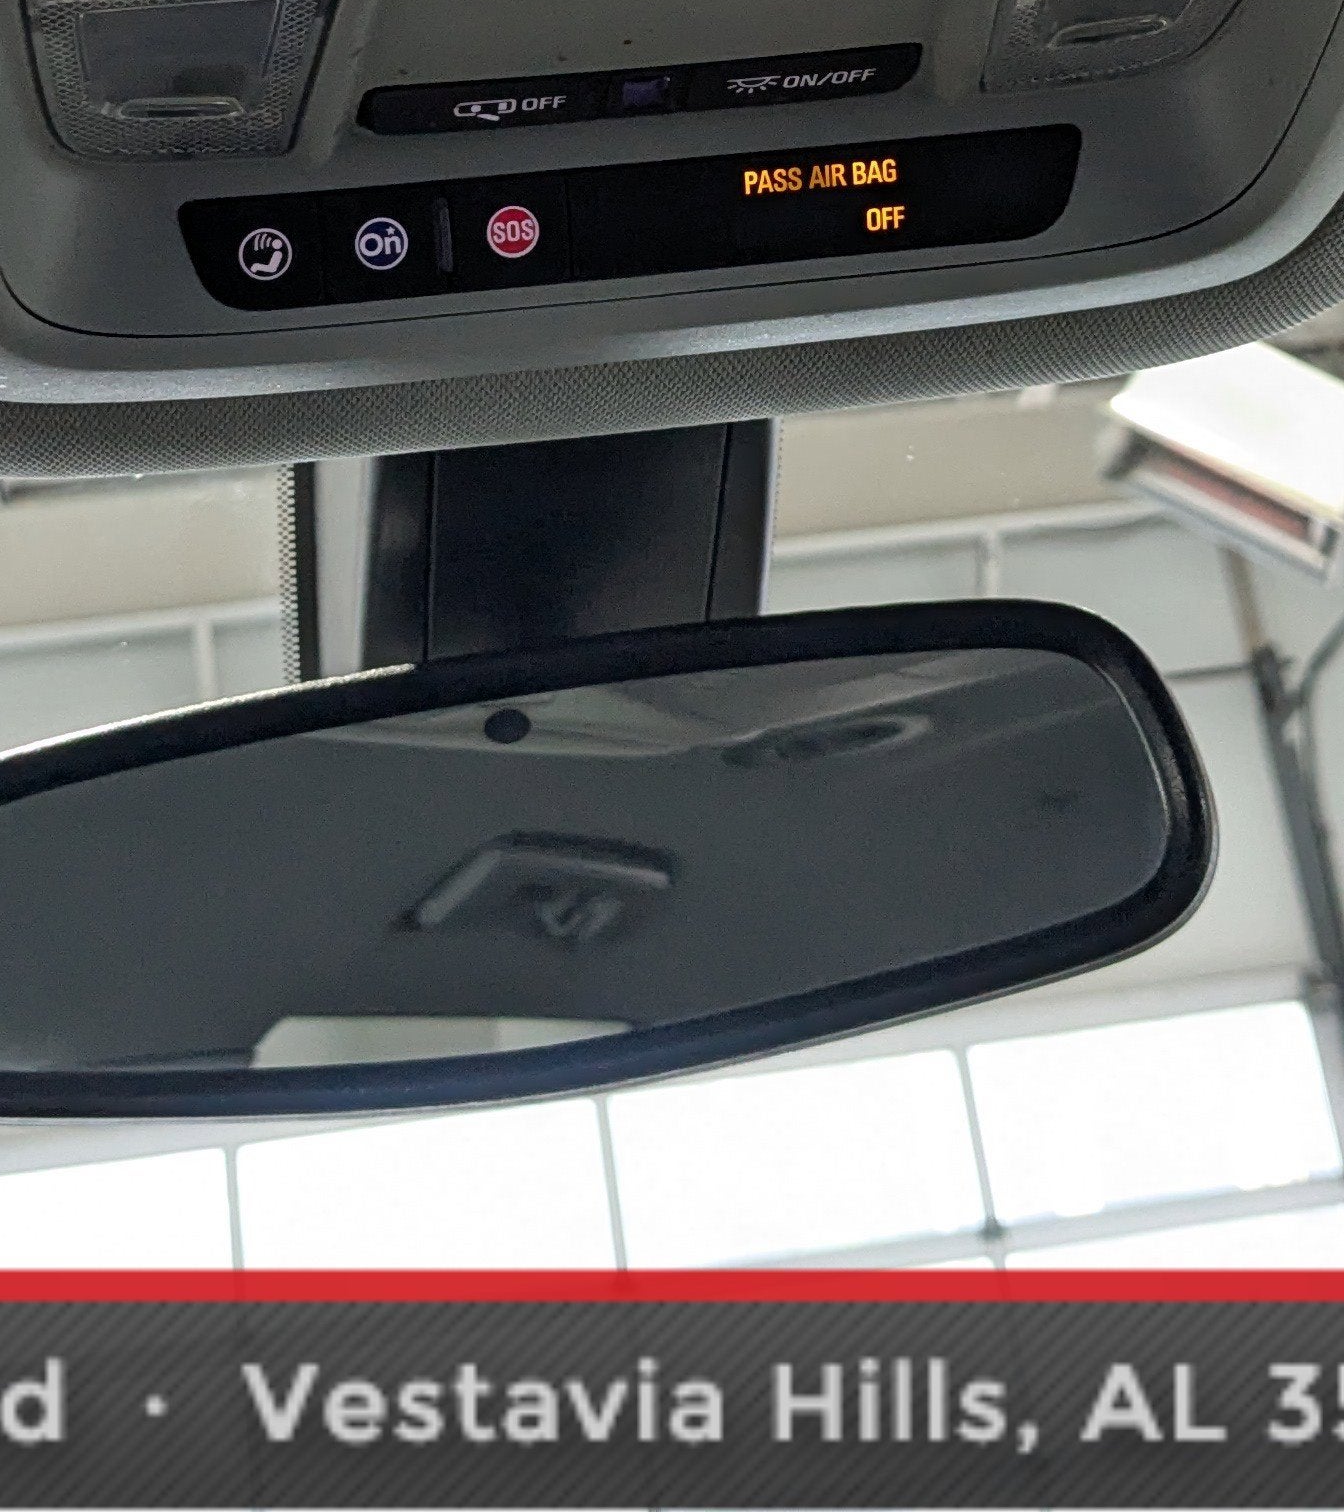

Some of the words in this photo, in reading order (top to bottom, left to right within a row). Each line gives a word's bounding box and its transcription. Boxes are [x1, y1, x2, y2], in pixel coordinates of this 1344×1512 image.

[783, 68, 877, 89] ON/OFF
[522, 95, 567, 111] OFF
[744, 167, 803, 195] PASS
[809, 163, 847, 189] AIR
[852, 159, 897, 185] BAG
[866, 206, 905, 231] OFF
[493, 219, 534, 244] SOS
[359, 232, 402, 257] On
